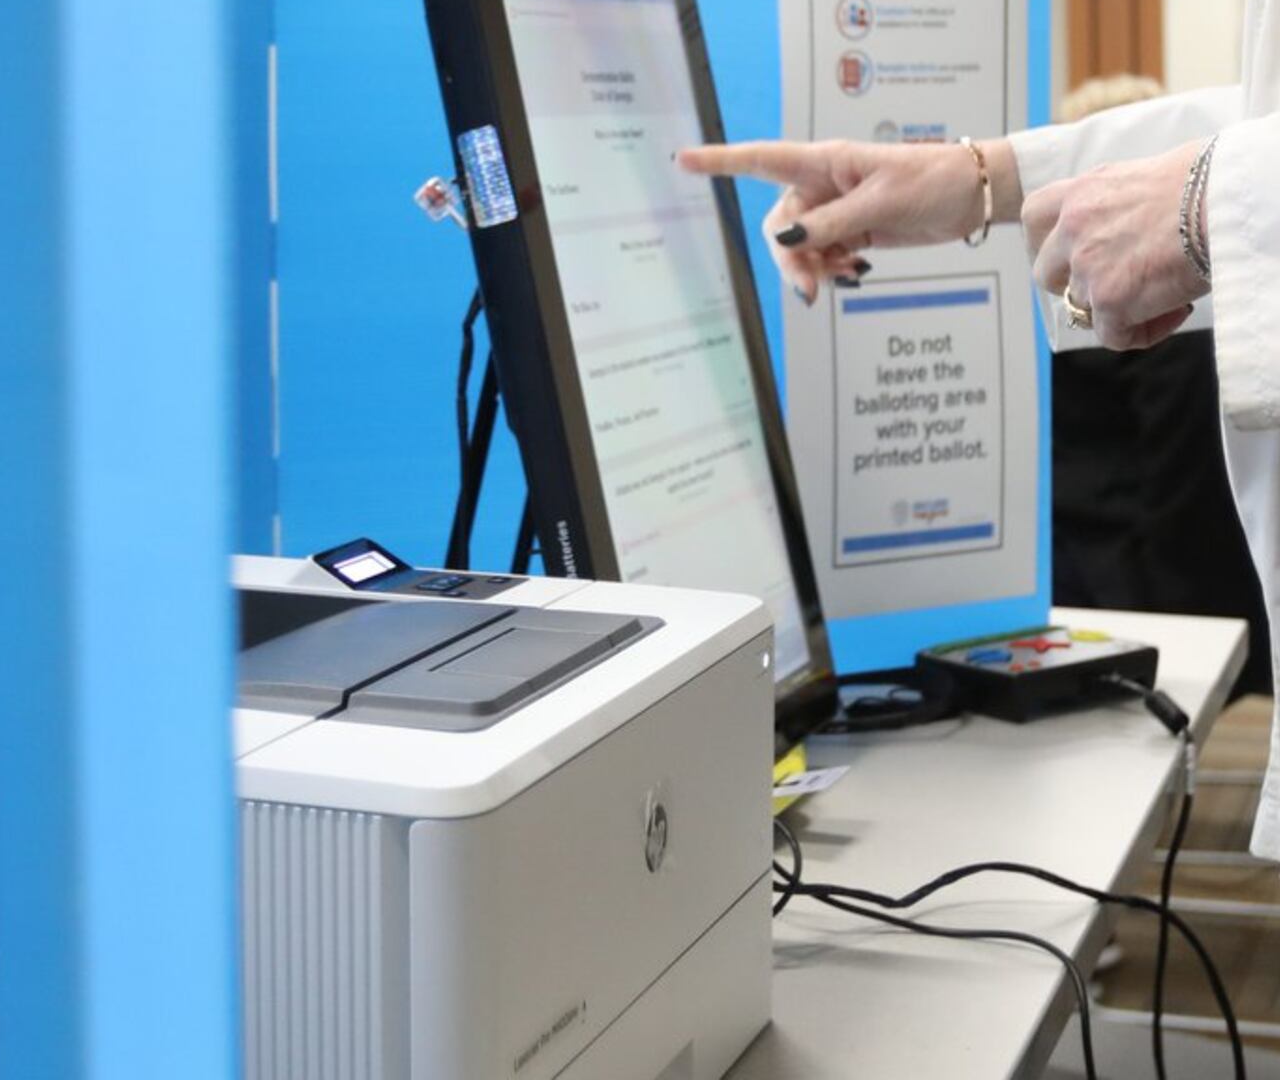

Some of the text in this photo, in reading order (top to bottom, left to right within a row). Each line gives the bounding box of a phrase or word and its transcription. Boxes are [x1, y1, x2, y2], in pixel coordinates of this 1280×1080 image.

[887, 333, 952, 358] Do not
[876, 360, 966, 385] leave the
[854, 388, 987, 417] balloting area
[876, 416, 966, 444] with your
[853, 438, 989, 475] printed ballot.
